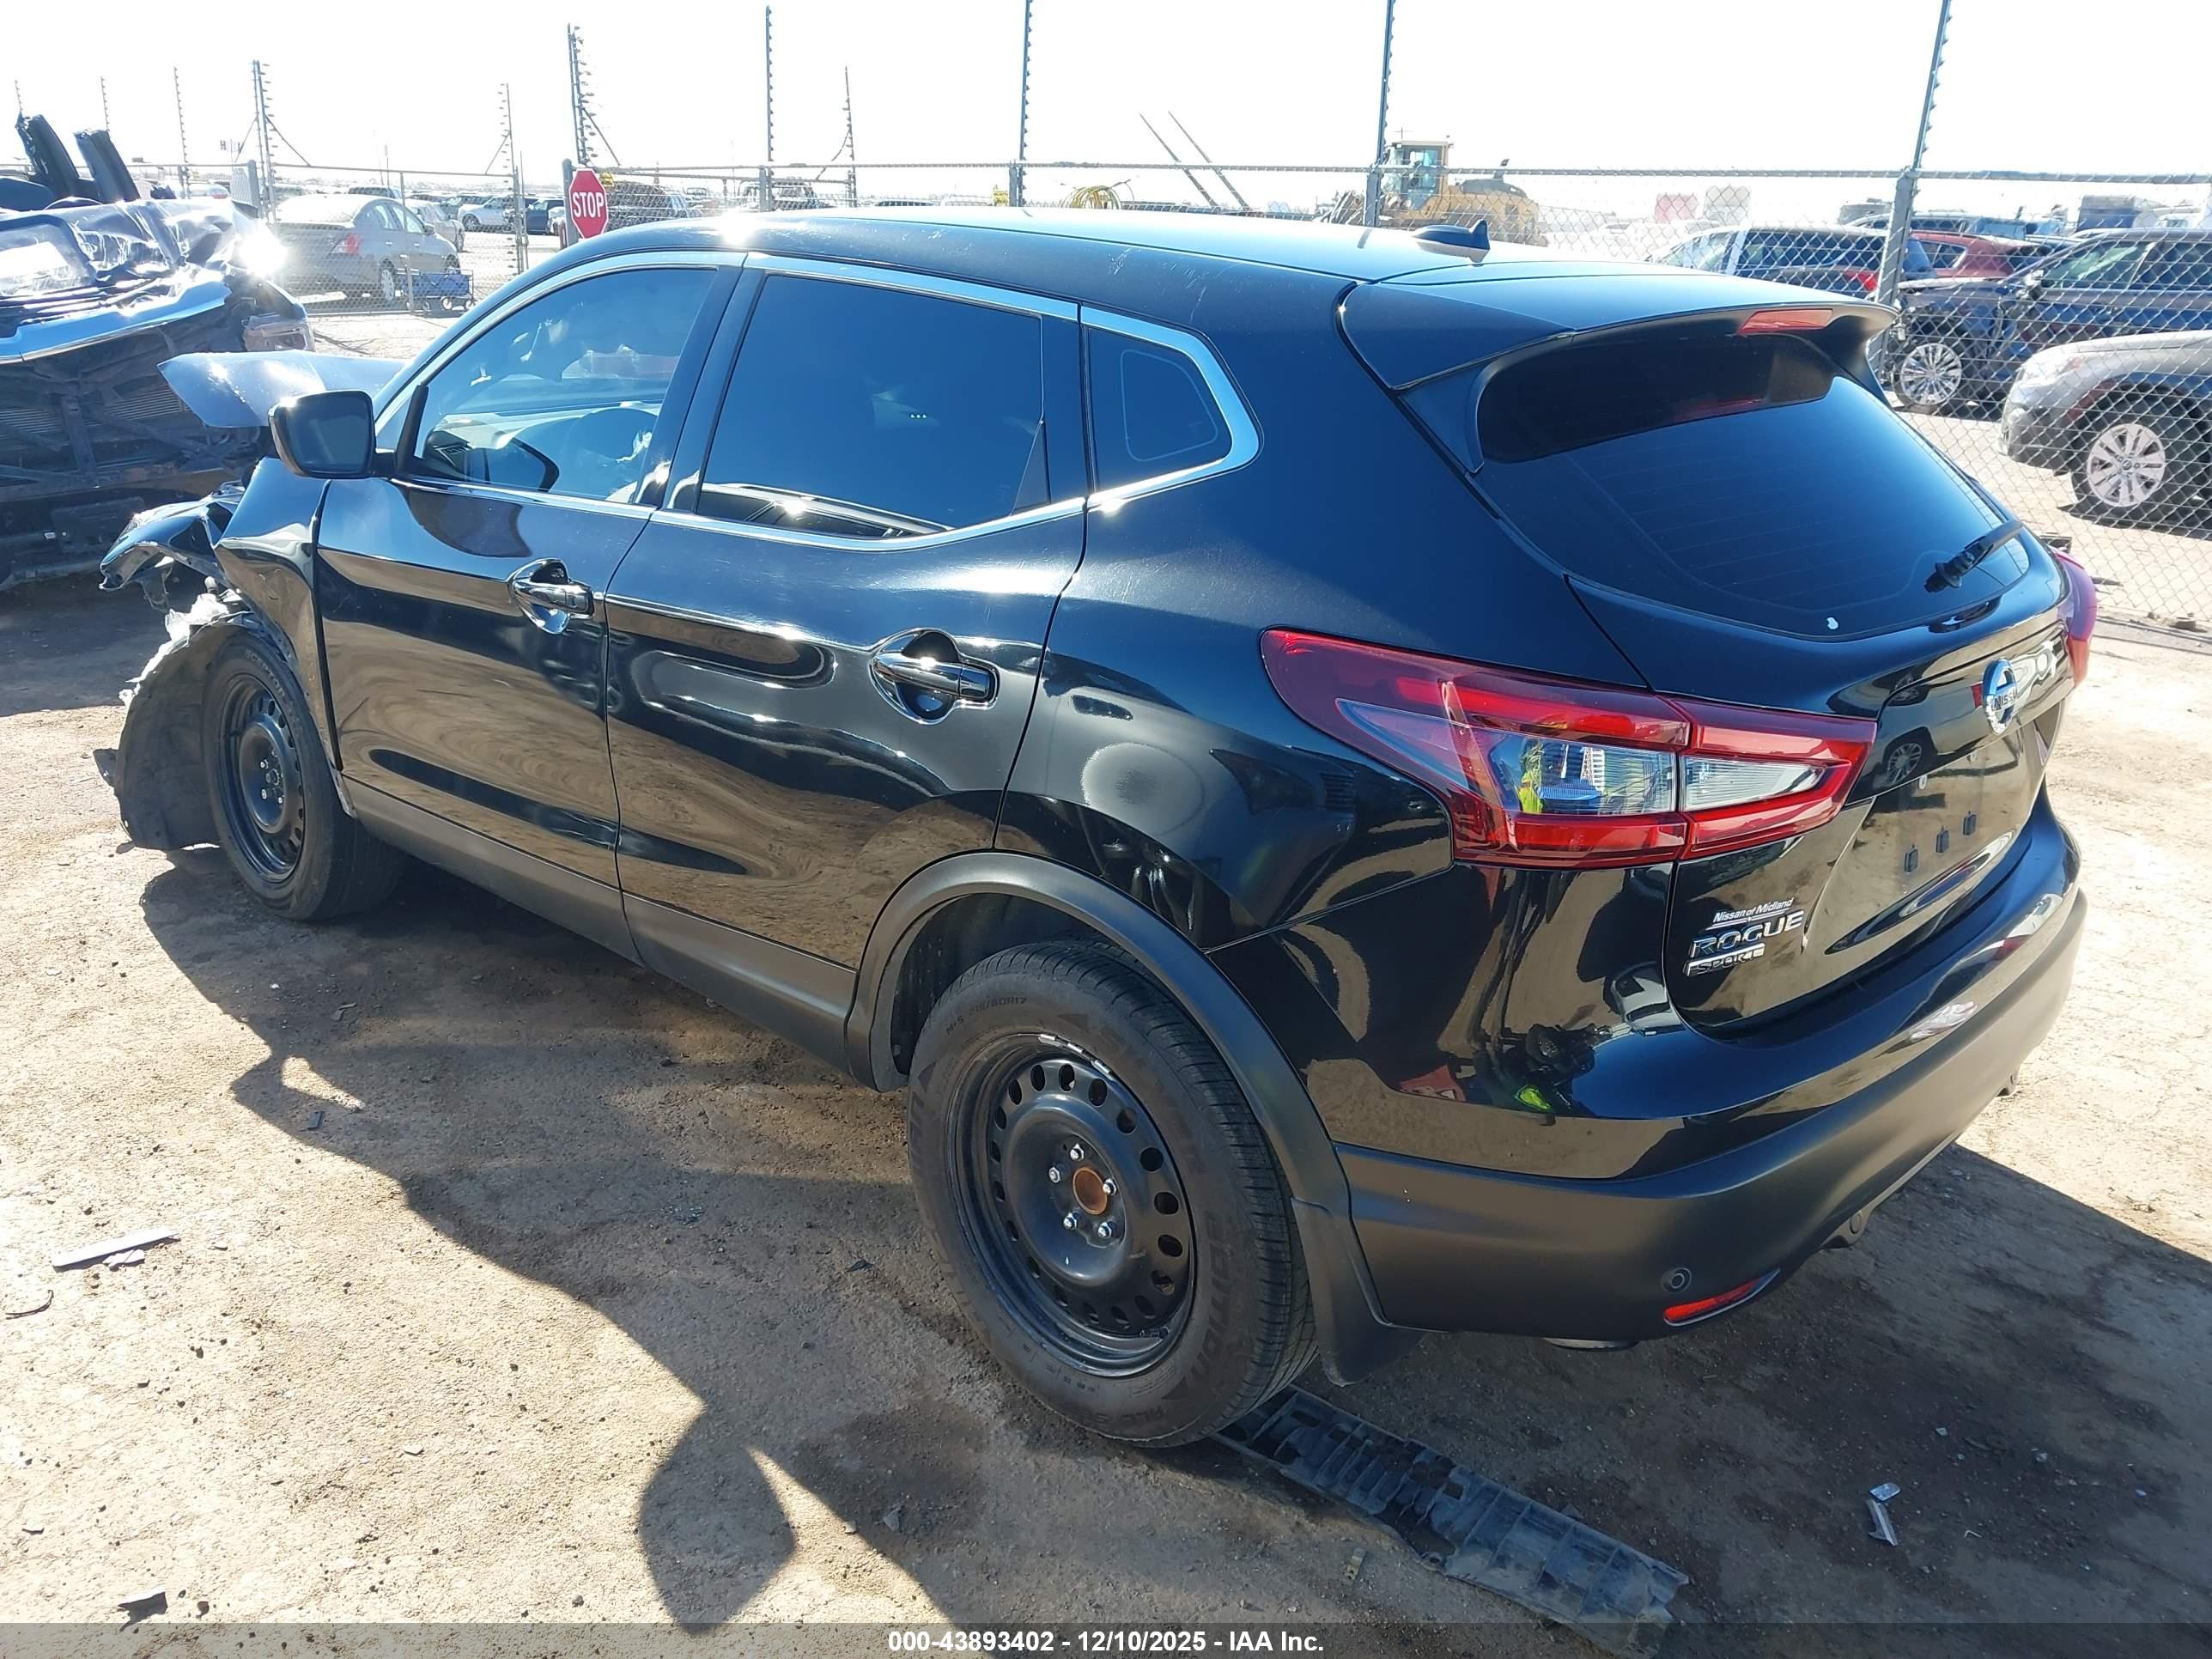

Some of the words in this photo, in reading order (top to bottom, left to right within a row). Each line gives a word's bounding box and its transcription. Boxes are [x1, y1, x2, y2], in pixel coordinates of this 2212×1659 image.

[573, 191, 605, 218] STOP
[1991, 687, 2018, 711] NISS
[1713, 909, 1747, 923] Nissan
[1746, 906, 1756, 916] of
[1755, 898, 1794, 915] Midland
[1688, 910, 1804, 958] ROGUE
[1695, 947, 1764, 975] SPORT
